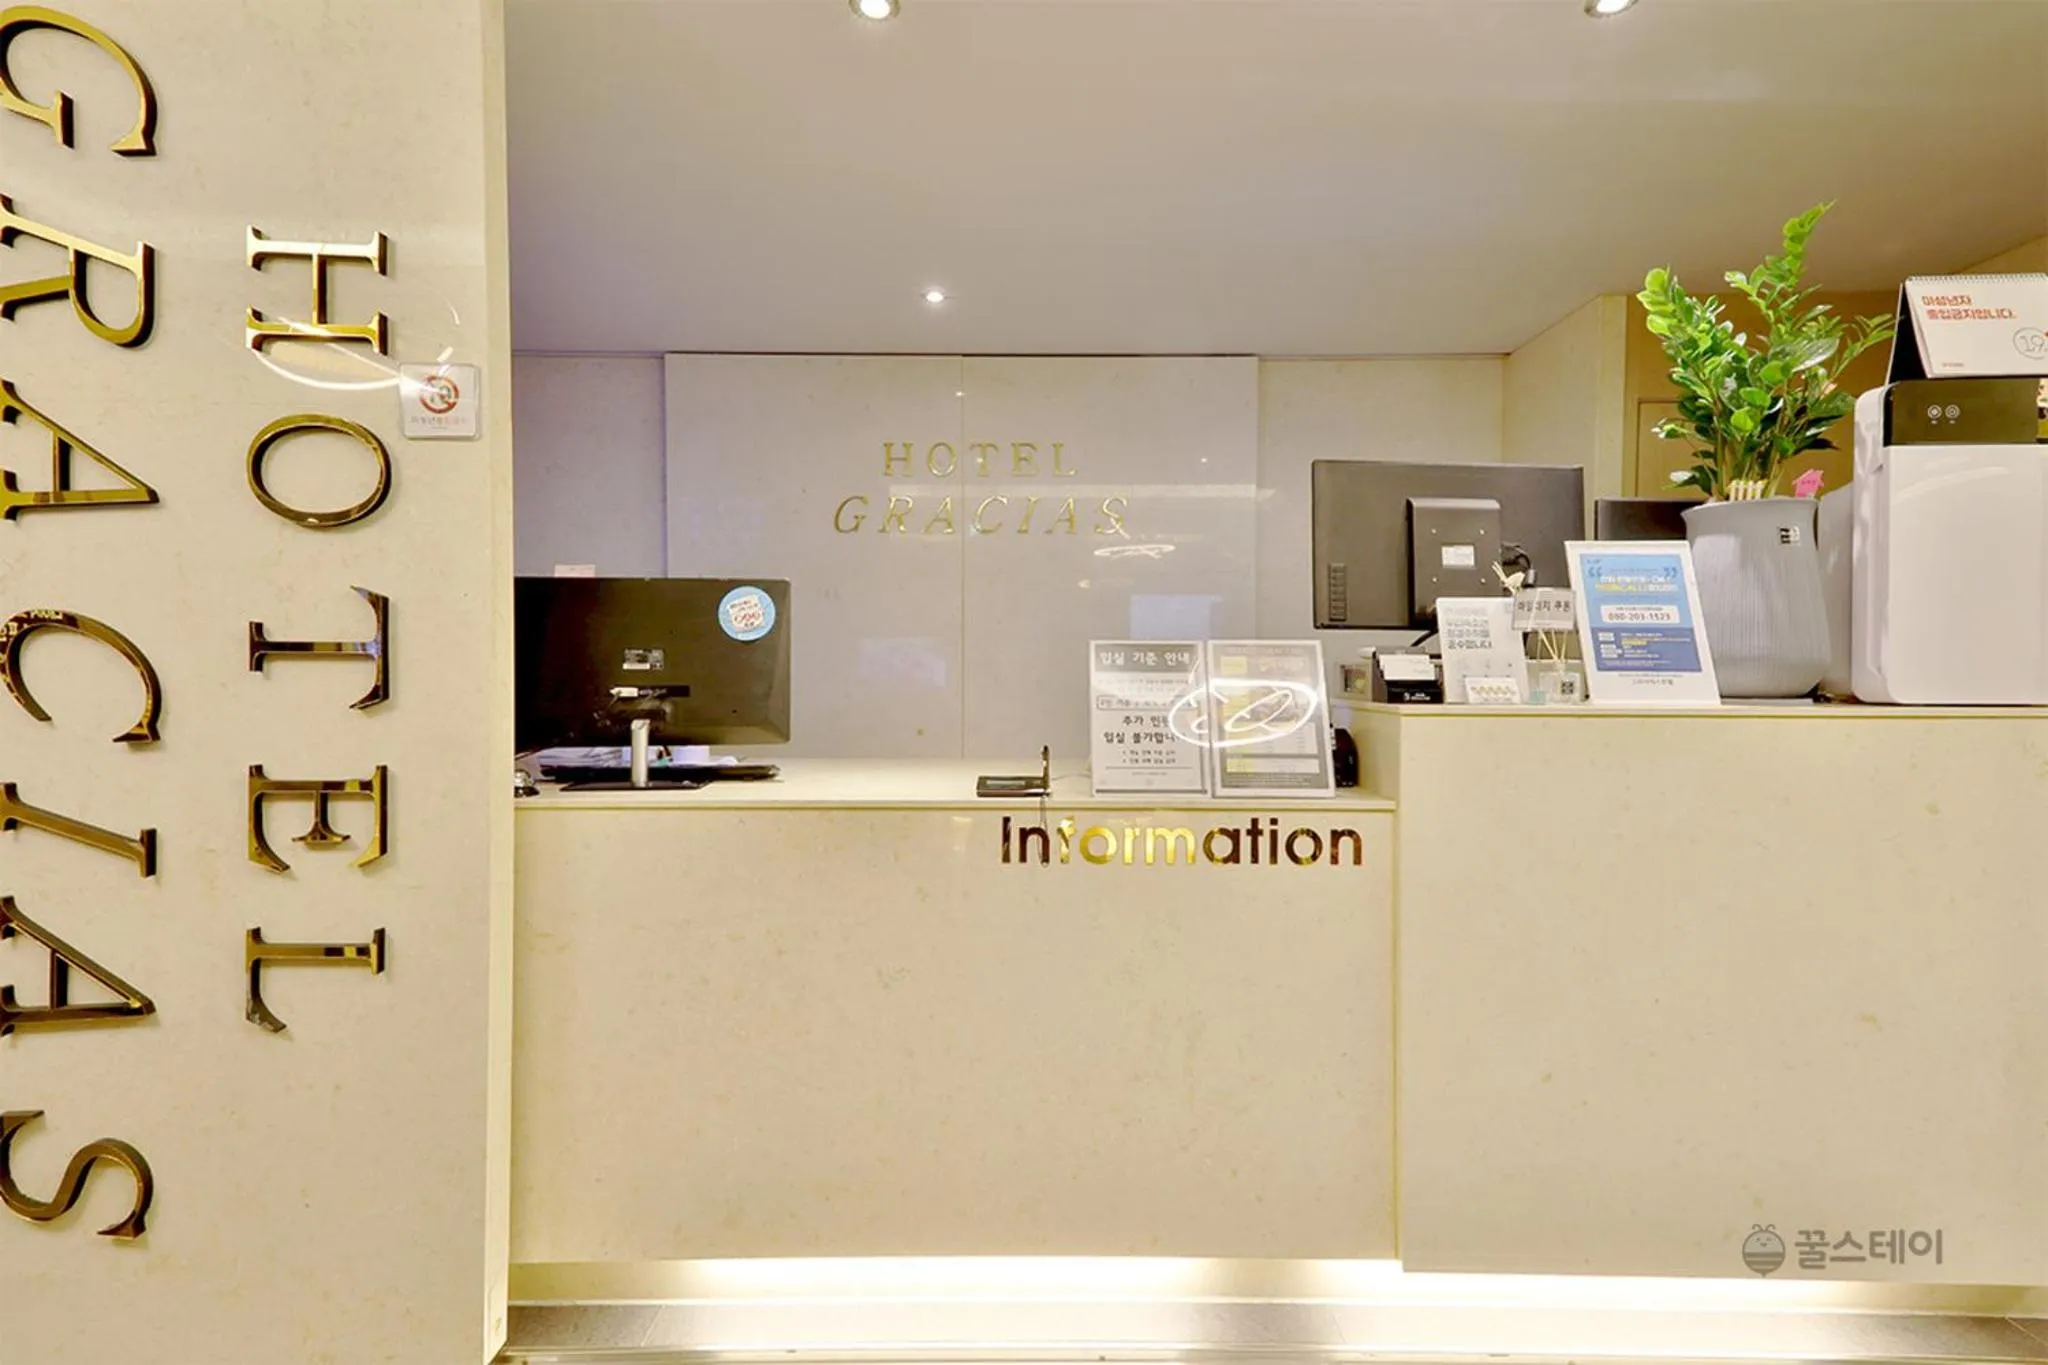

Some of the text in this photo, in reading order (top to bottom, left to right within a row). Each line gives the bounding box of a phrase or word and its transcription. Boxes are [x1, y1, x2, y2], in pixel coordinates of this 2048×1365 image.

[882, 442, 1078, 477] HOTEL
[833, 494, 1128, 535] GRACIAS
[0, 5, 160, 1242] GRACIAS
[246, 225, 391, 1033] HOTEL
[1100, 651, 1190, 667] 입실 기준 안내
[1132, 732, 1186, 744] 불가합니
[1001, 816, 1363, 866] Information
